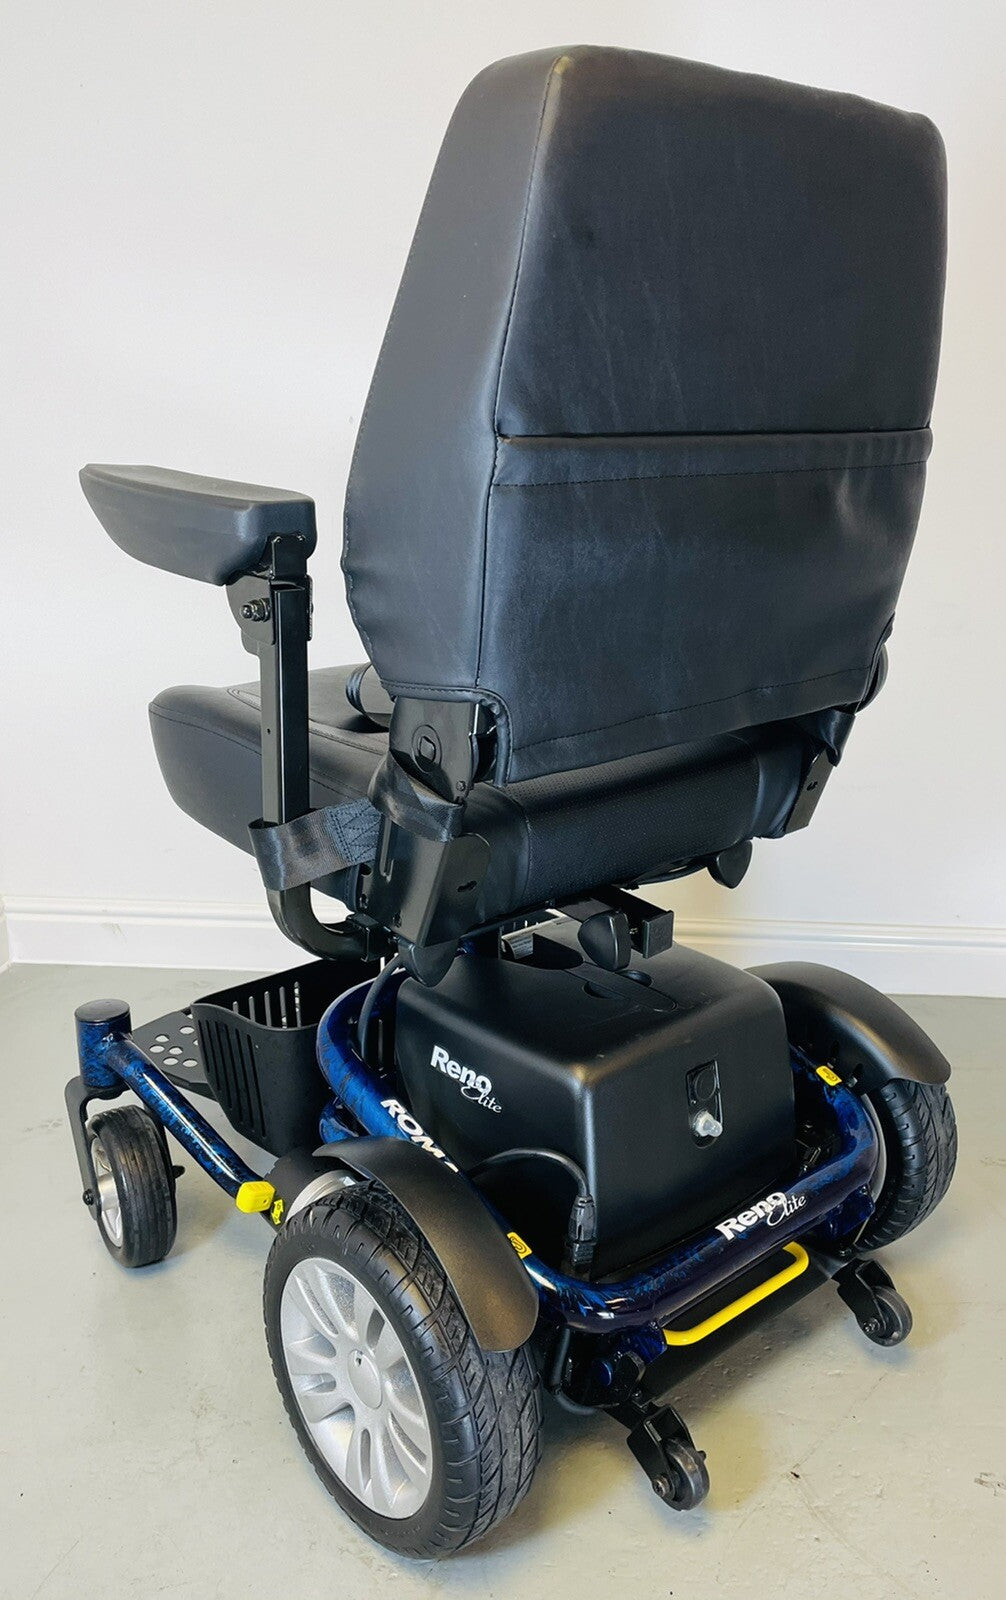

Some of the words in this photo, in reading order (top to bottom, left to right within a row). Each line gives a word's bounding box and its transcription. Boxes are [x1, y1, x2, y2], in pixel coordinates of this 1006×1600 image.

[430, 1045, 492, 1094] Reno
[460, 1080, 502, 1113] Elite
[380, 1099, 459, 1173] ROM
[714, 1192, 788, 1240] Reno
[766, 1195, 807, 1227] Elite
